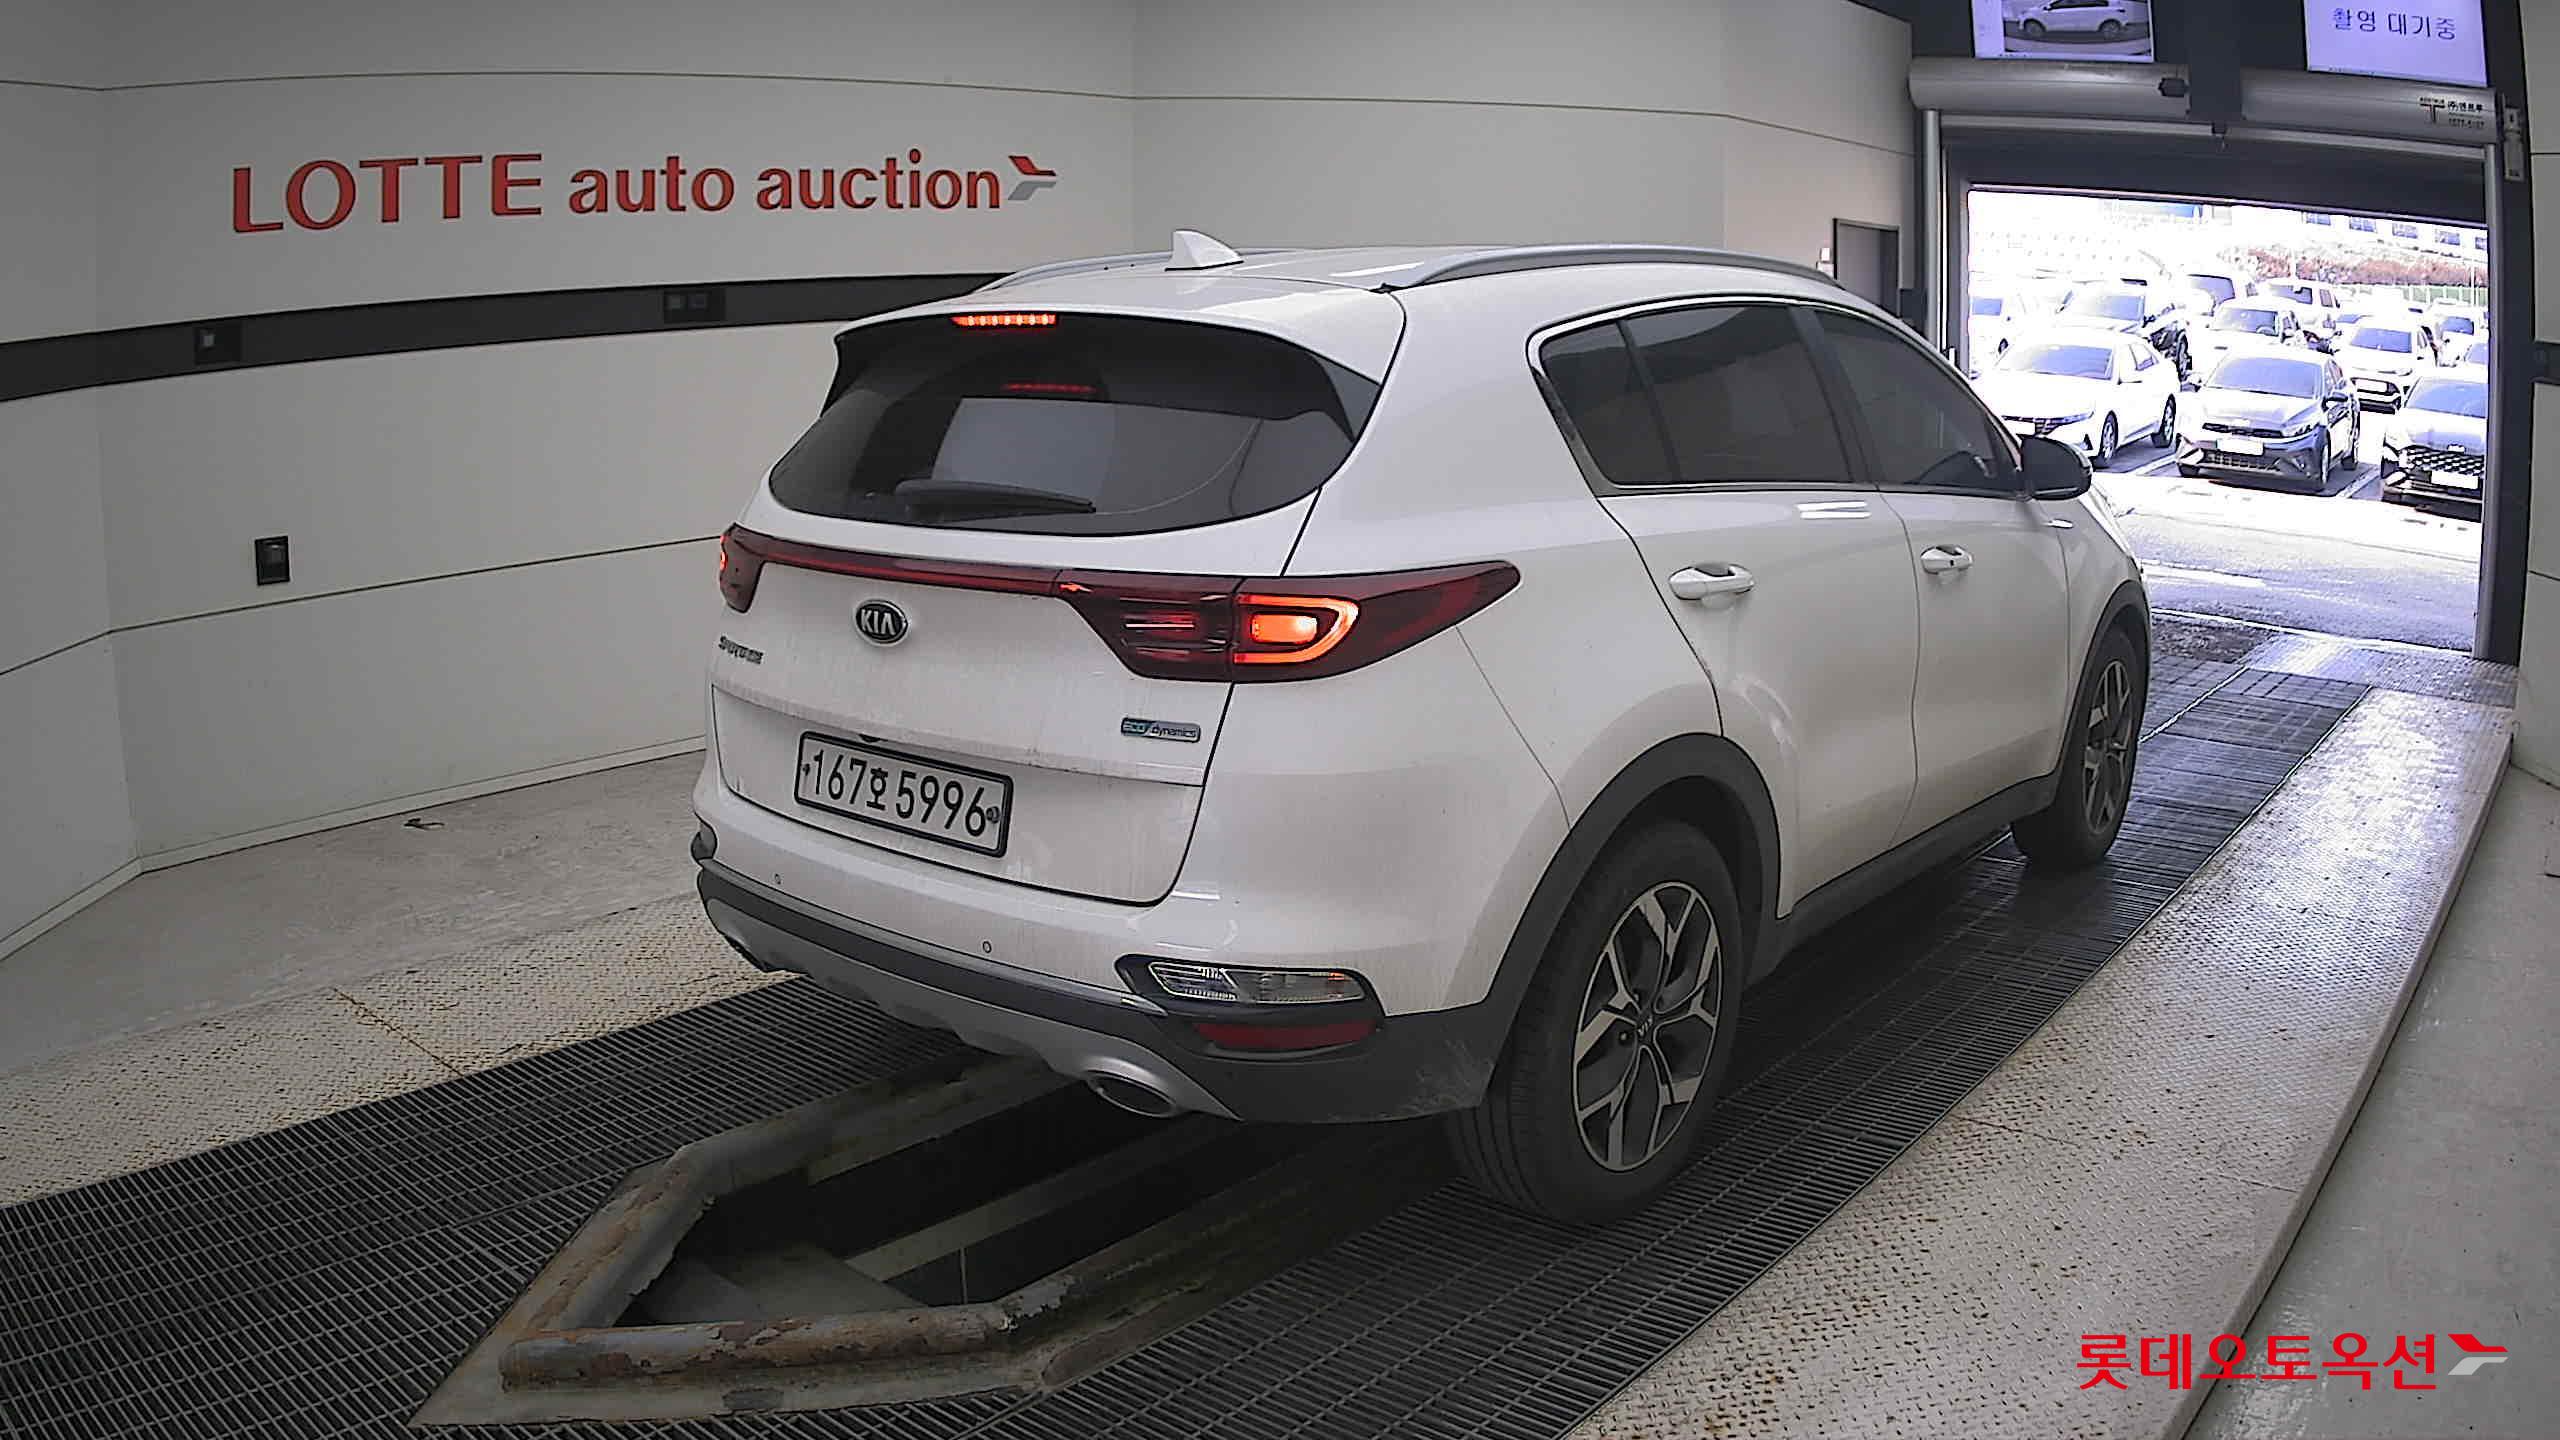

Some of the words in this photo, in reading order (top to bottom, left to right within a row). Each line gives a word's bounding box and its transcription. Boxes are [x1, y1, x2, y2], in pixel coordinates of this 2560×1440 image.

[2334, 8, 2376, 33] 촬영
[2387, 13, 2456, 40] 대기중
[234, 154, 542, 233] LOTTE
[569, 155, 734, 213] auto
[757, 148, 1001, 209] auction
[861, 609, 897, 636] KIA
